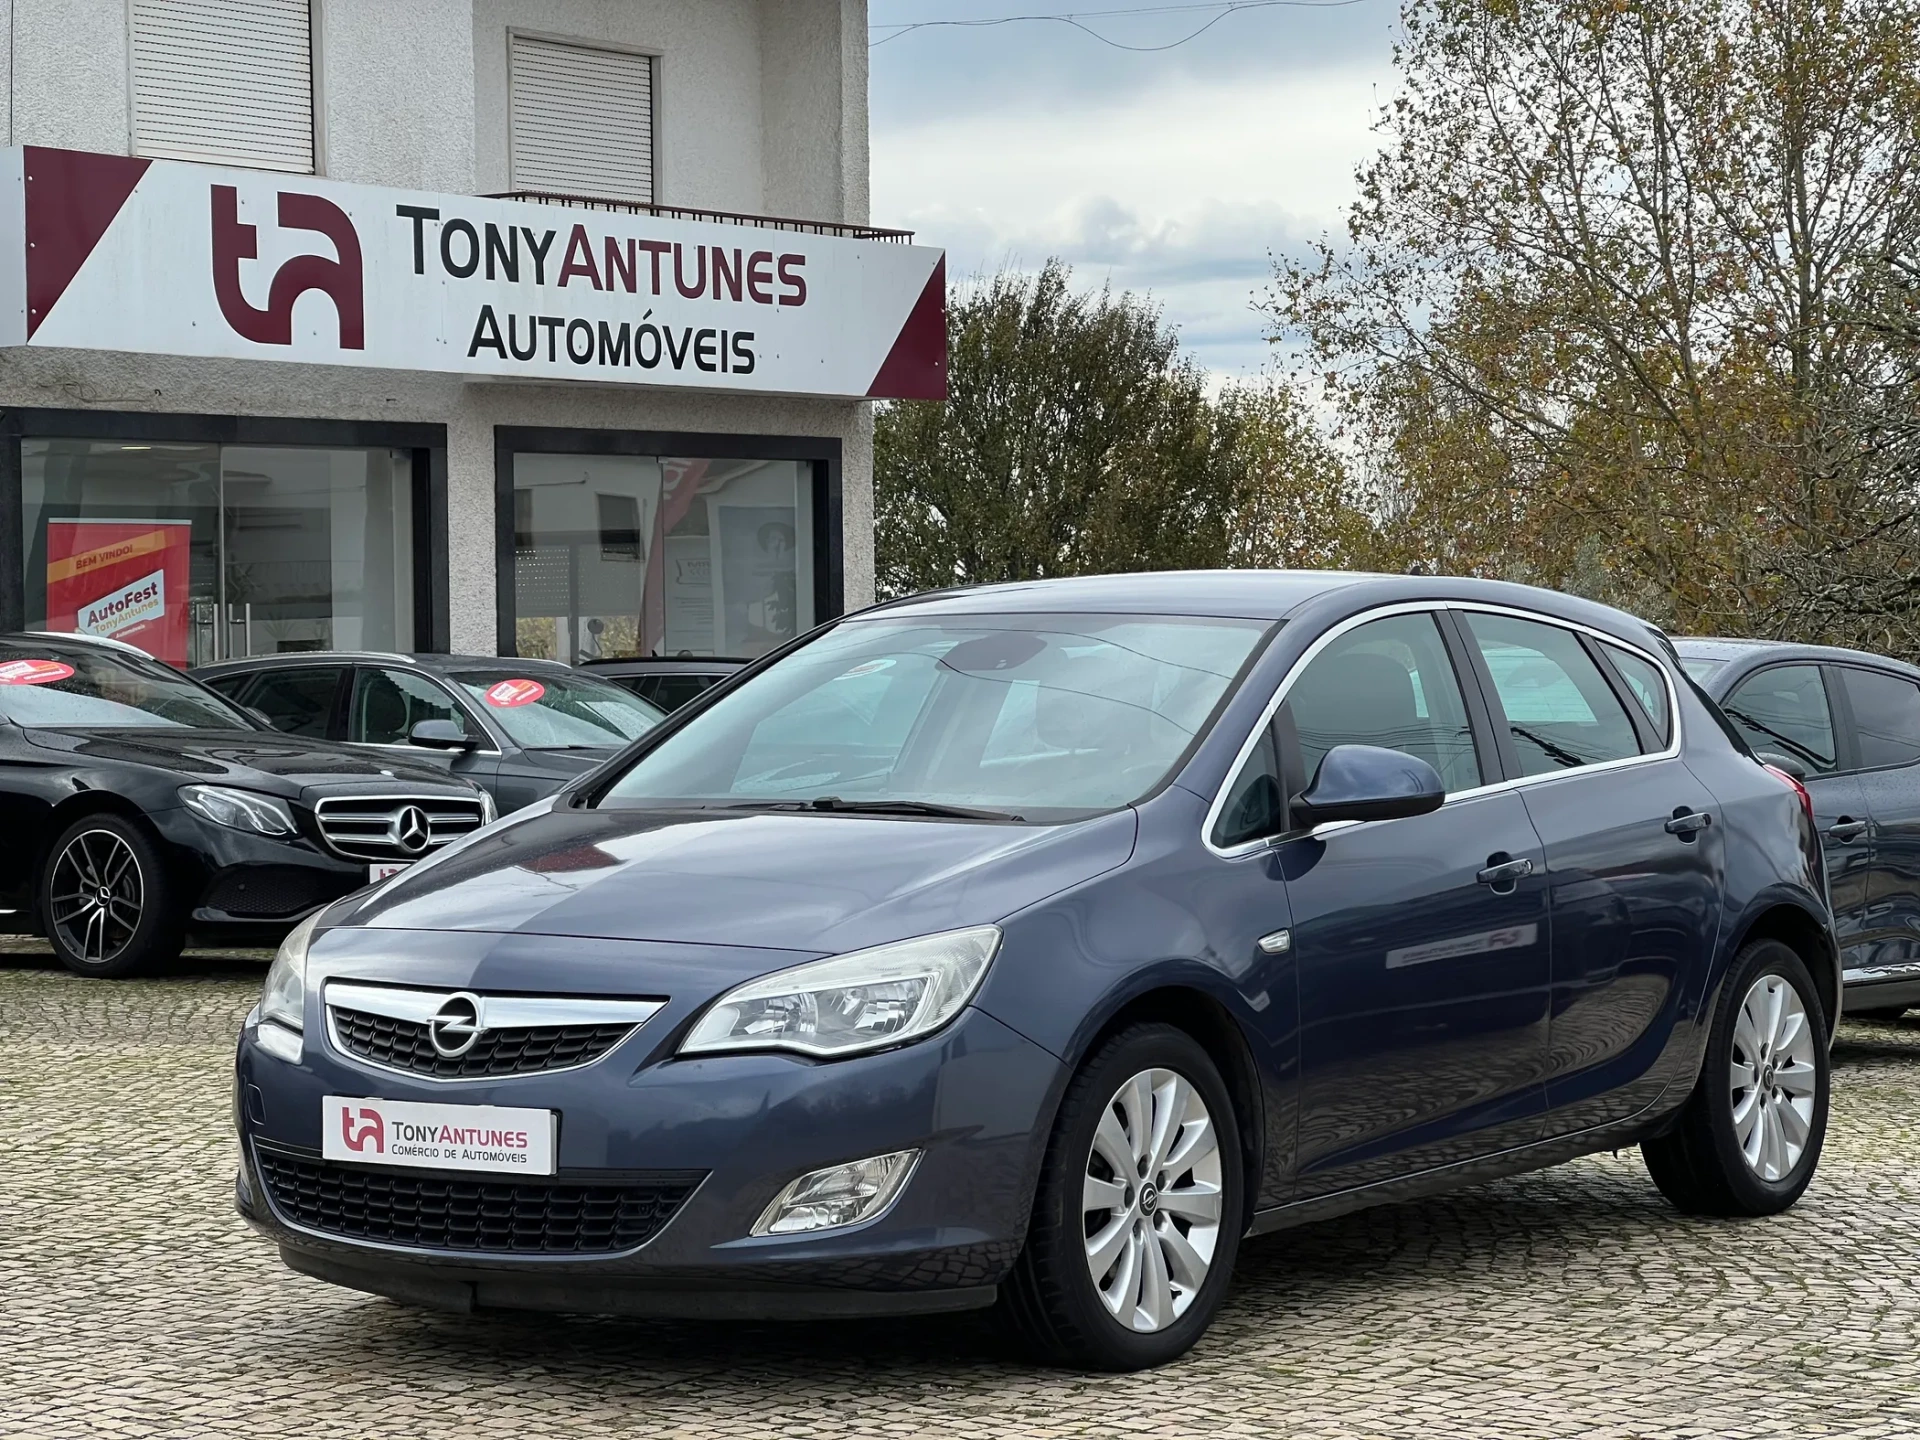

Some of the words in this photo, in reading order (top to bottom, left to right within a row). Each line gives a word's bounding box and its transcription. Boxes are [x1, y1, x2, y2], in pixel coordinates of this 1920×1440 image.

[76, 555, 97, 569] BEM
[99, 544, 133, 562] VINDO!
[87, 582, 158, 628] AutoFest
[94, 599, 159, 634] TonyAntunes
[444, 1149, 457, 1159] DE
